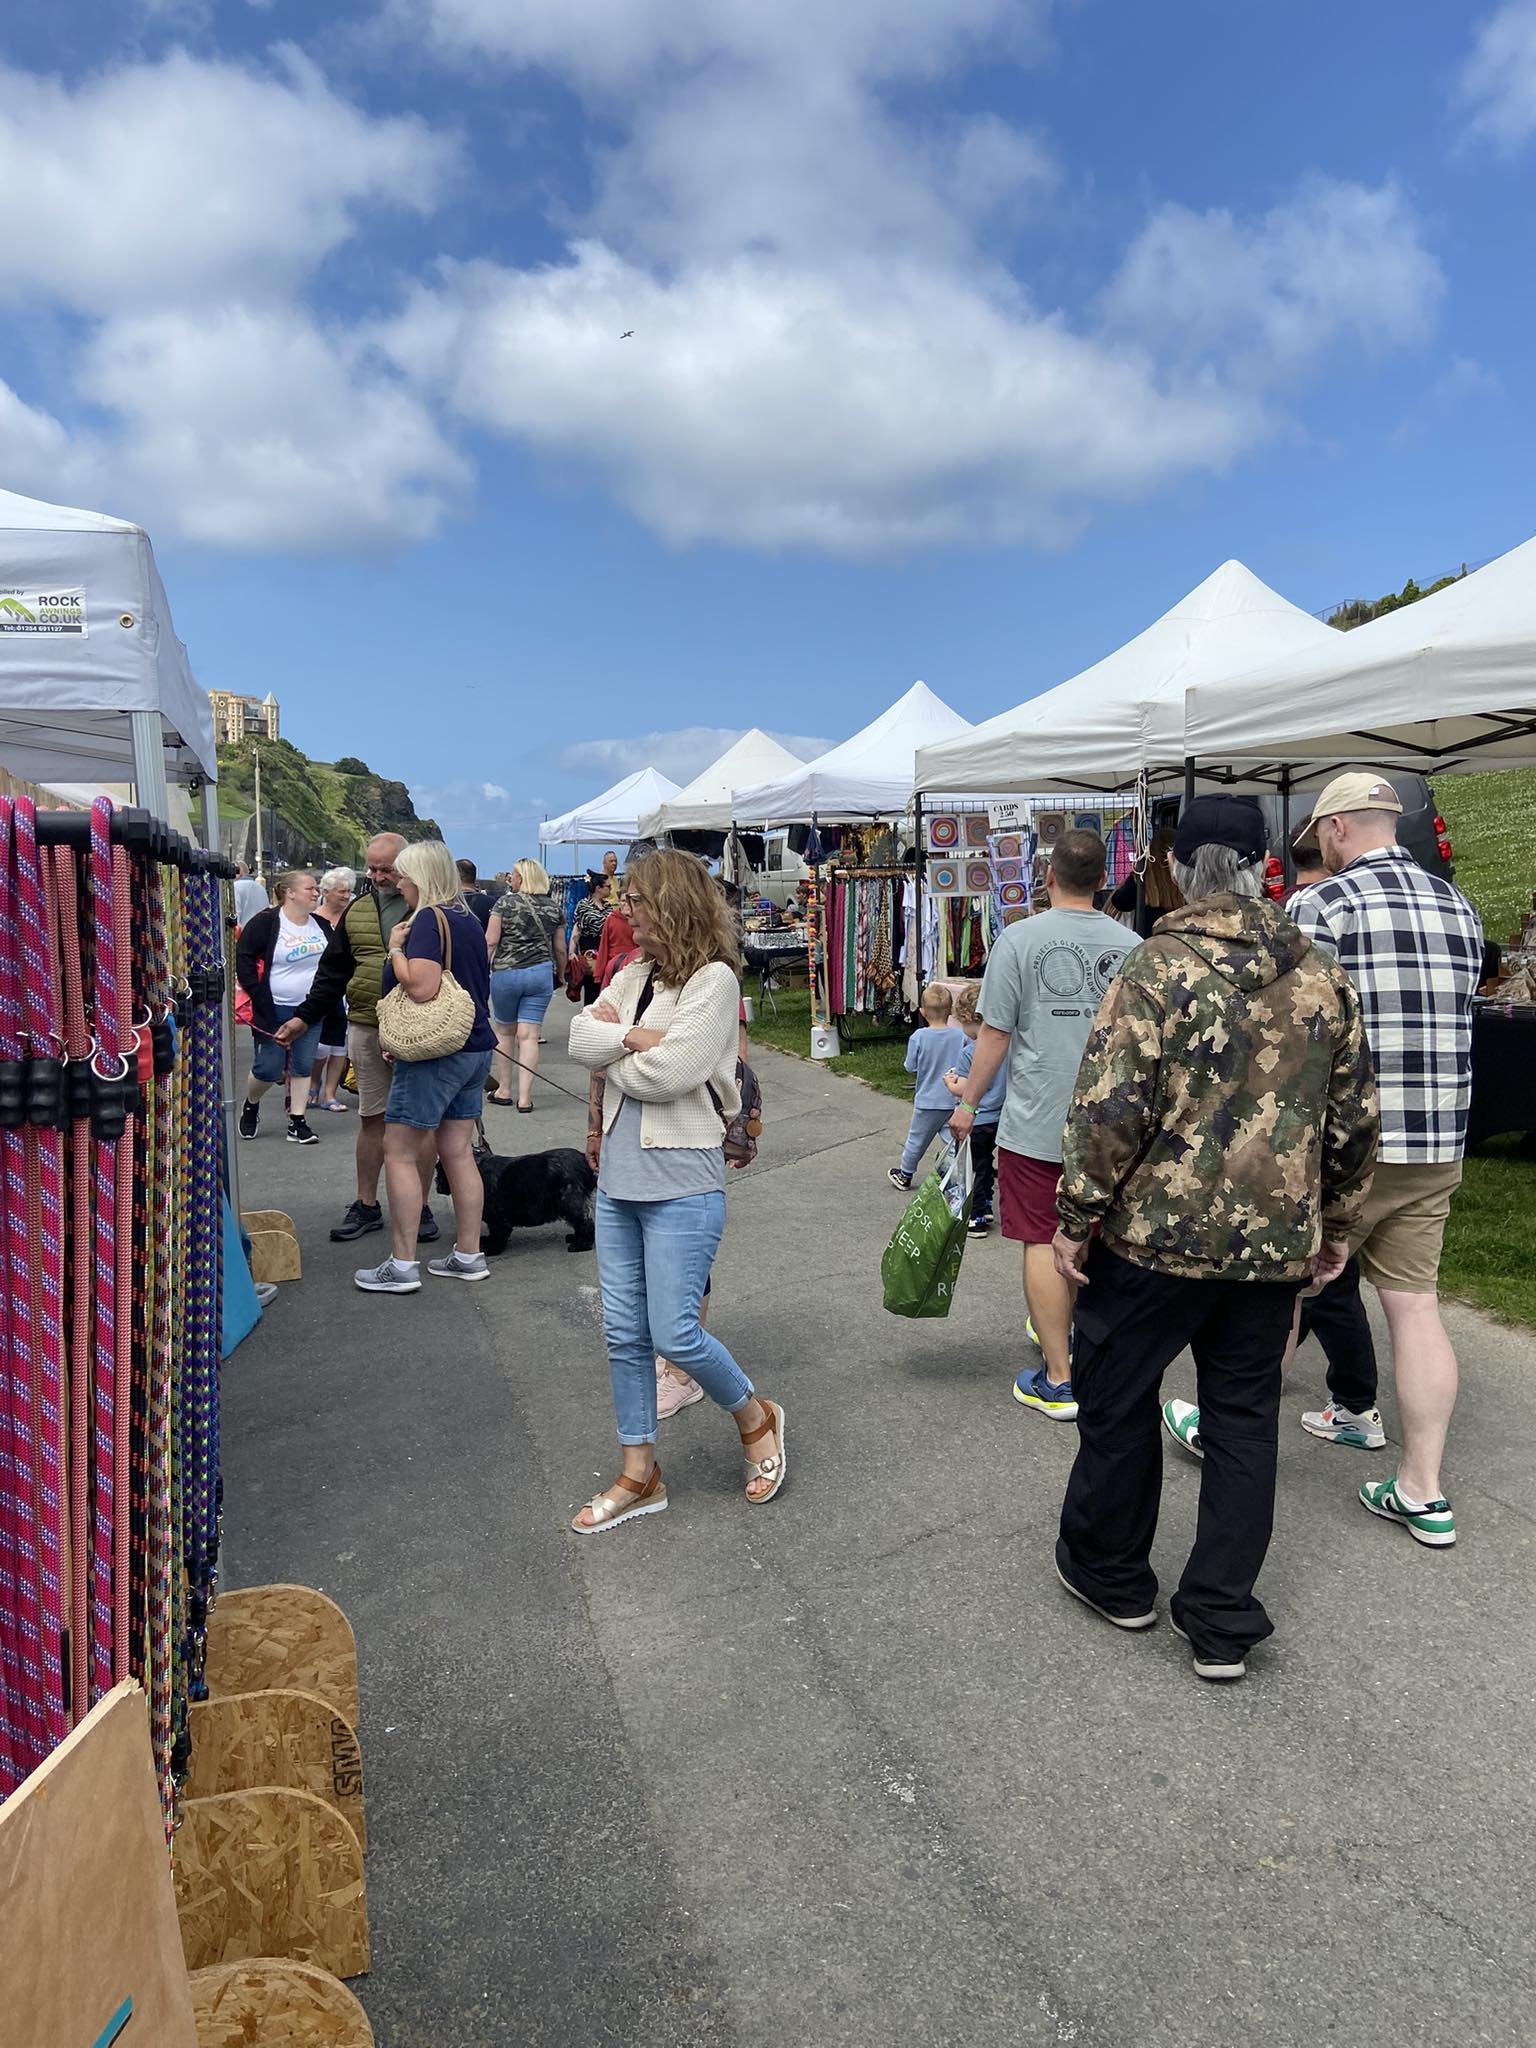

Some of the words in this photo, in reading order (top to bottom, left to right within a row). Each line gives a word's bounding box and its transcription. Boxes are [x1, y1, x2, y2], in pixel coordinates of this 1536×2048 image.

[38, 596, 80, 606] ROCK
[39, 607, 82, 615] AWNINGS
[39, 614, 82, 623] CO.UK
[993, 803, 1019, 811] CARDS
[1033, 940, 1059, 970] PROJECTS
[1060, 939, 1086, 959] GLOBAL
